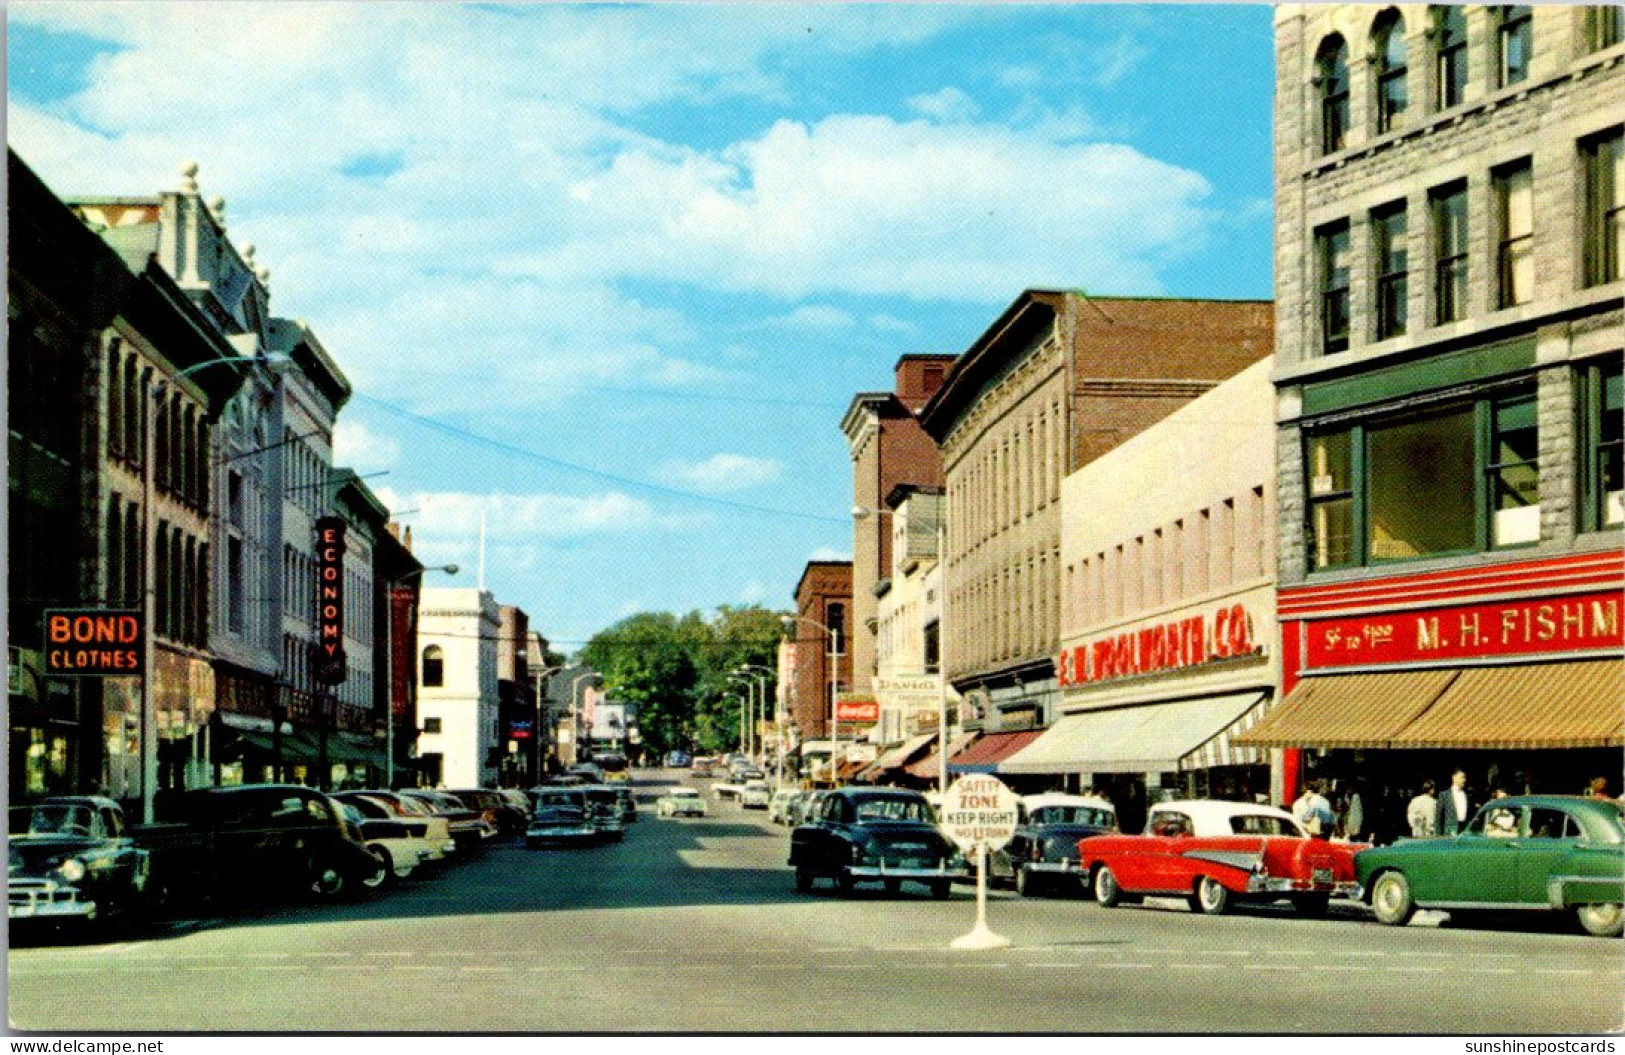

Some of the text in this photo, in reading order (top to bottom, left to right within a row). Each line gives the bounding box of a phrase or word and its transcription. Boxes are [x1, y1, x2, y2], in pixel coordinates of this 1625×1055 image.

[323, 529, 338, 656] ECONOMY
[49, 615, 138, 644] BOND
[1417, 600, 1618, 650] M. H. FISHM
[1093, 615, 1205, 681] WOOLWORTH
[1215, 603, 1251, 657] CO.
[1346, 636, 1360, 649] TO
[51, 650, 138, 668] CLOTHES
[957, 780, 1001, 793] SAFETY
[960, 796, 1000, 809] ZONE
[947, 812, 1014, 825] KEEP RIGHT
